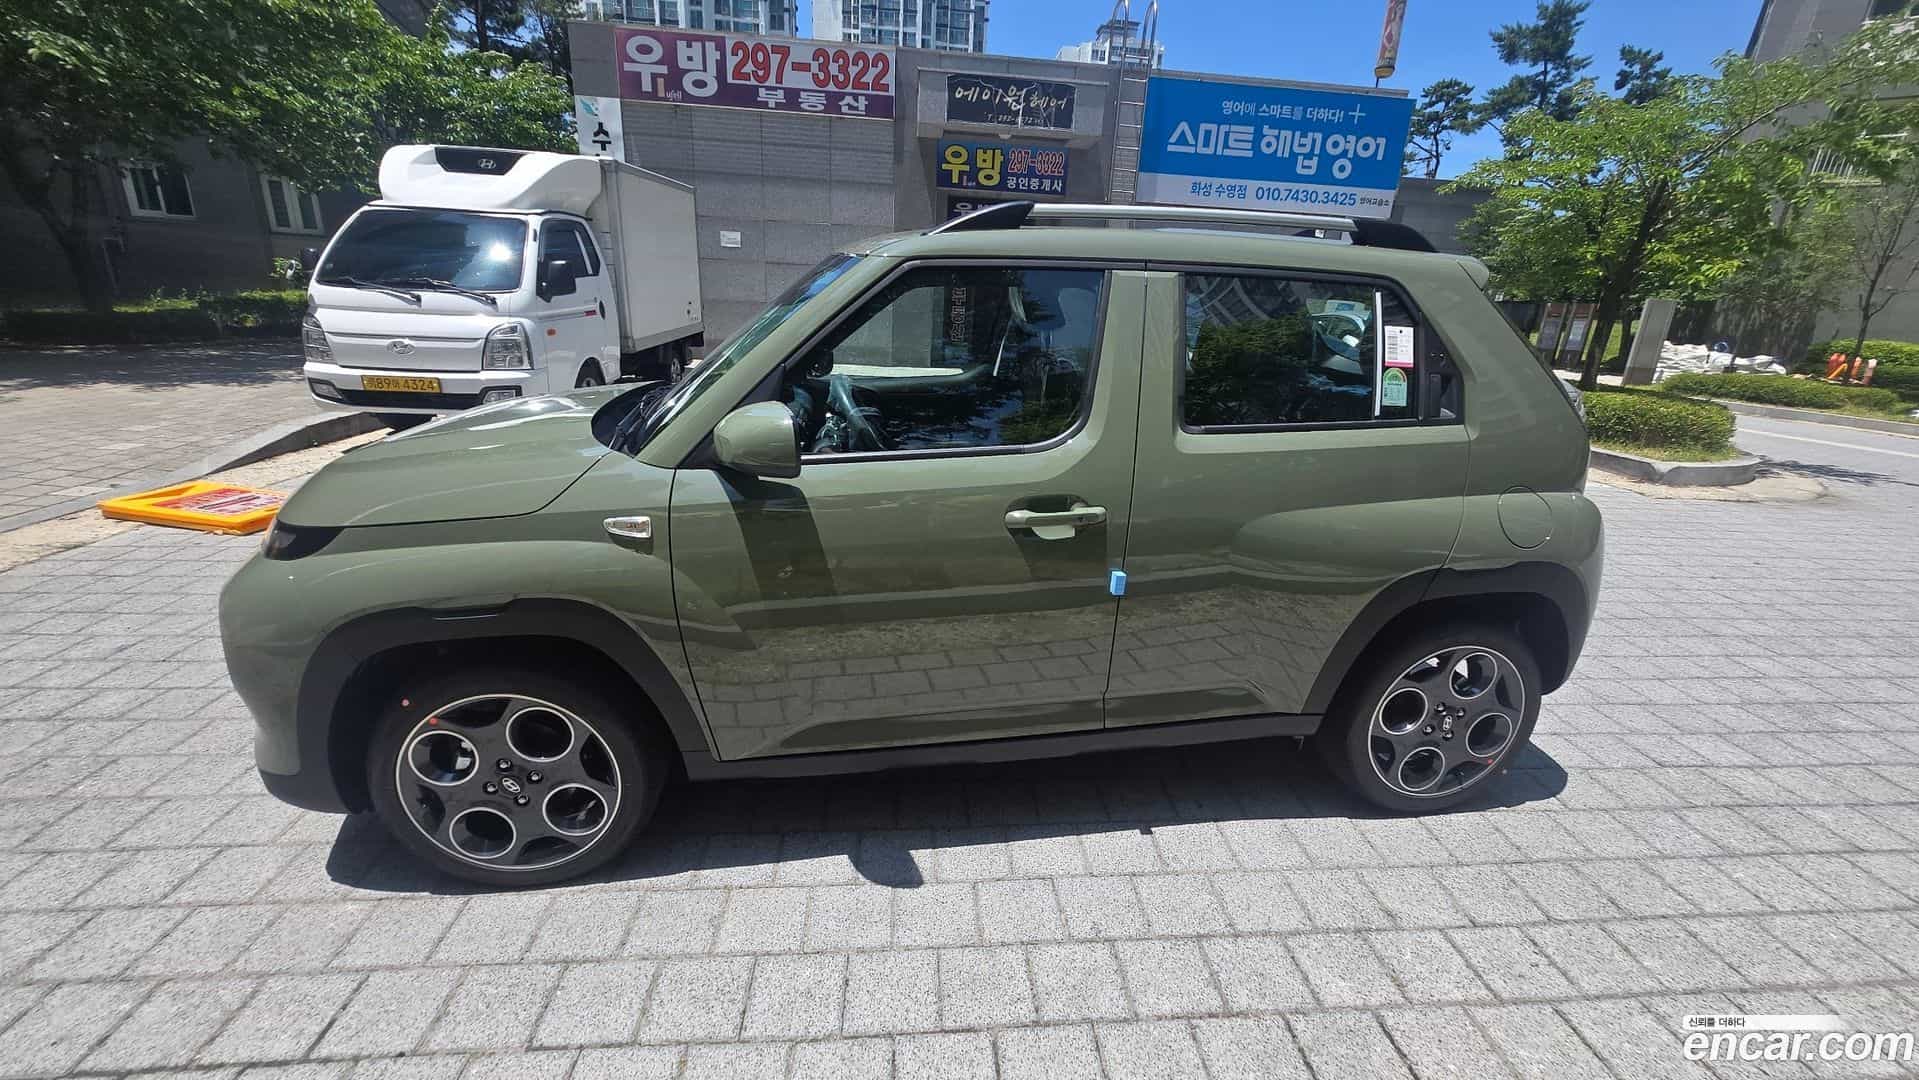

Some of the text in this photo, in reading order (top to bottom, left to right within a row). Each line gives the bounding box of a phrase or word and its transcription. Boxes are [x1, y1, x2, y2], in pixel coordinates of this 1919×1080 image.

[624, 35, 720, 97] 우방
[731, 41, 890, 93] 297-3322
[758, 87, 869, 116] 부동산
[1306, 107, 1343, 123] 더하다!
[1008, 148, 1065, 176] 297-3322
[1167, 121, 1387, 179] 스마트 해법 영어
[941, 145, 1004, 186] 우방
[1007, 176, 1063, 193] 공인중개사
[1191, 181, 1213, 197] 화성
[1215, 184, 1248, 199] 수영점
[1255, 187, 1357, 206] 010.7430.3425
[403, 379, 434, 391] 4324
